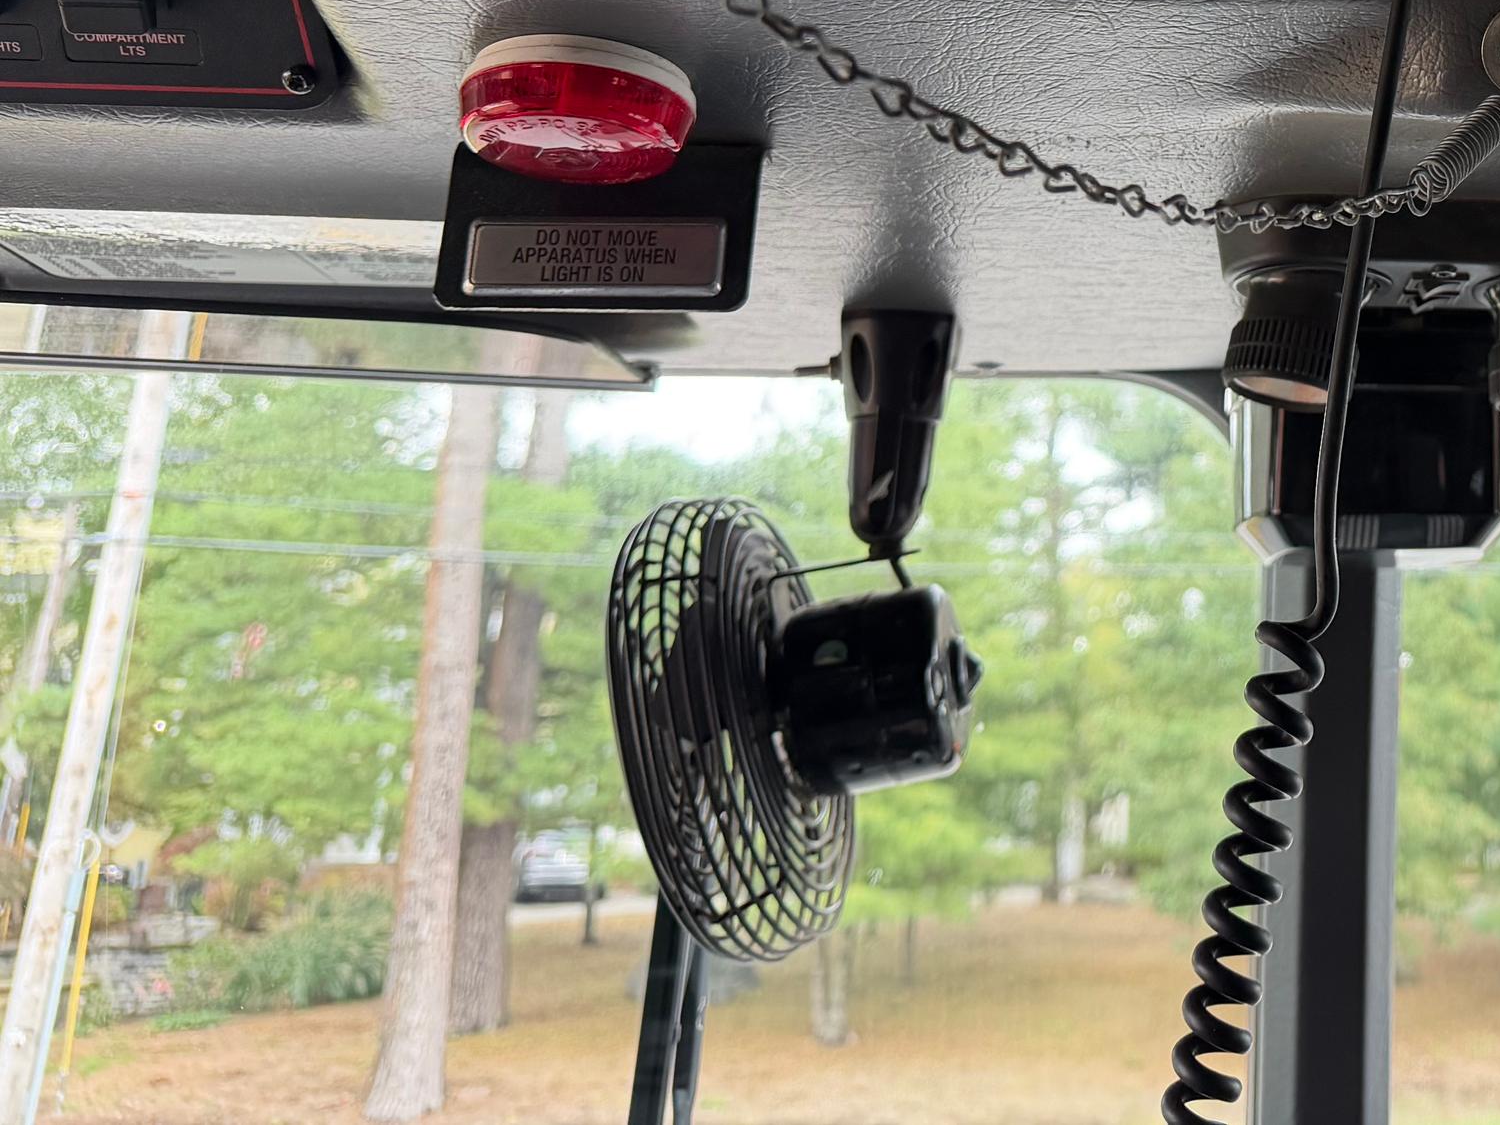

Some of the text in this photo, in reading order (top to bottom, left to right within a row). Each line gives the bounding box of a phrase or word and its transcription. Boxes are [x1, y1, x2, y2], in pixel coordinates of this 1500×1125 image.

[74, 33, 186, 44] COMPARTMENT
[119, 46, 146, 56] LTS
[536, 229, 658, 246] DO NOT MOVE
[512, 247, 677, 264] APPARATUS WHEN
[540, 265, 645, 282] LIGHT IS ON
